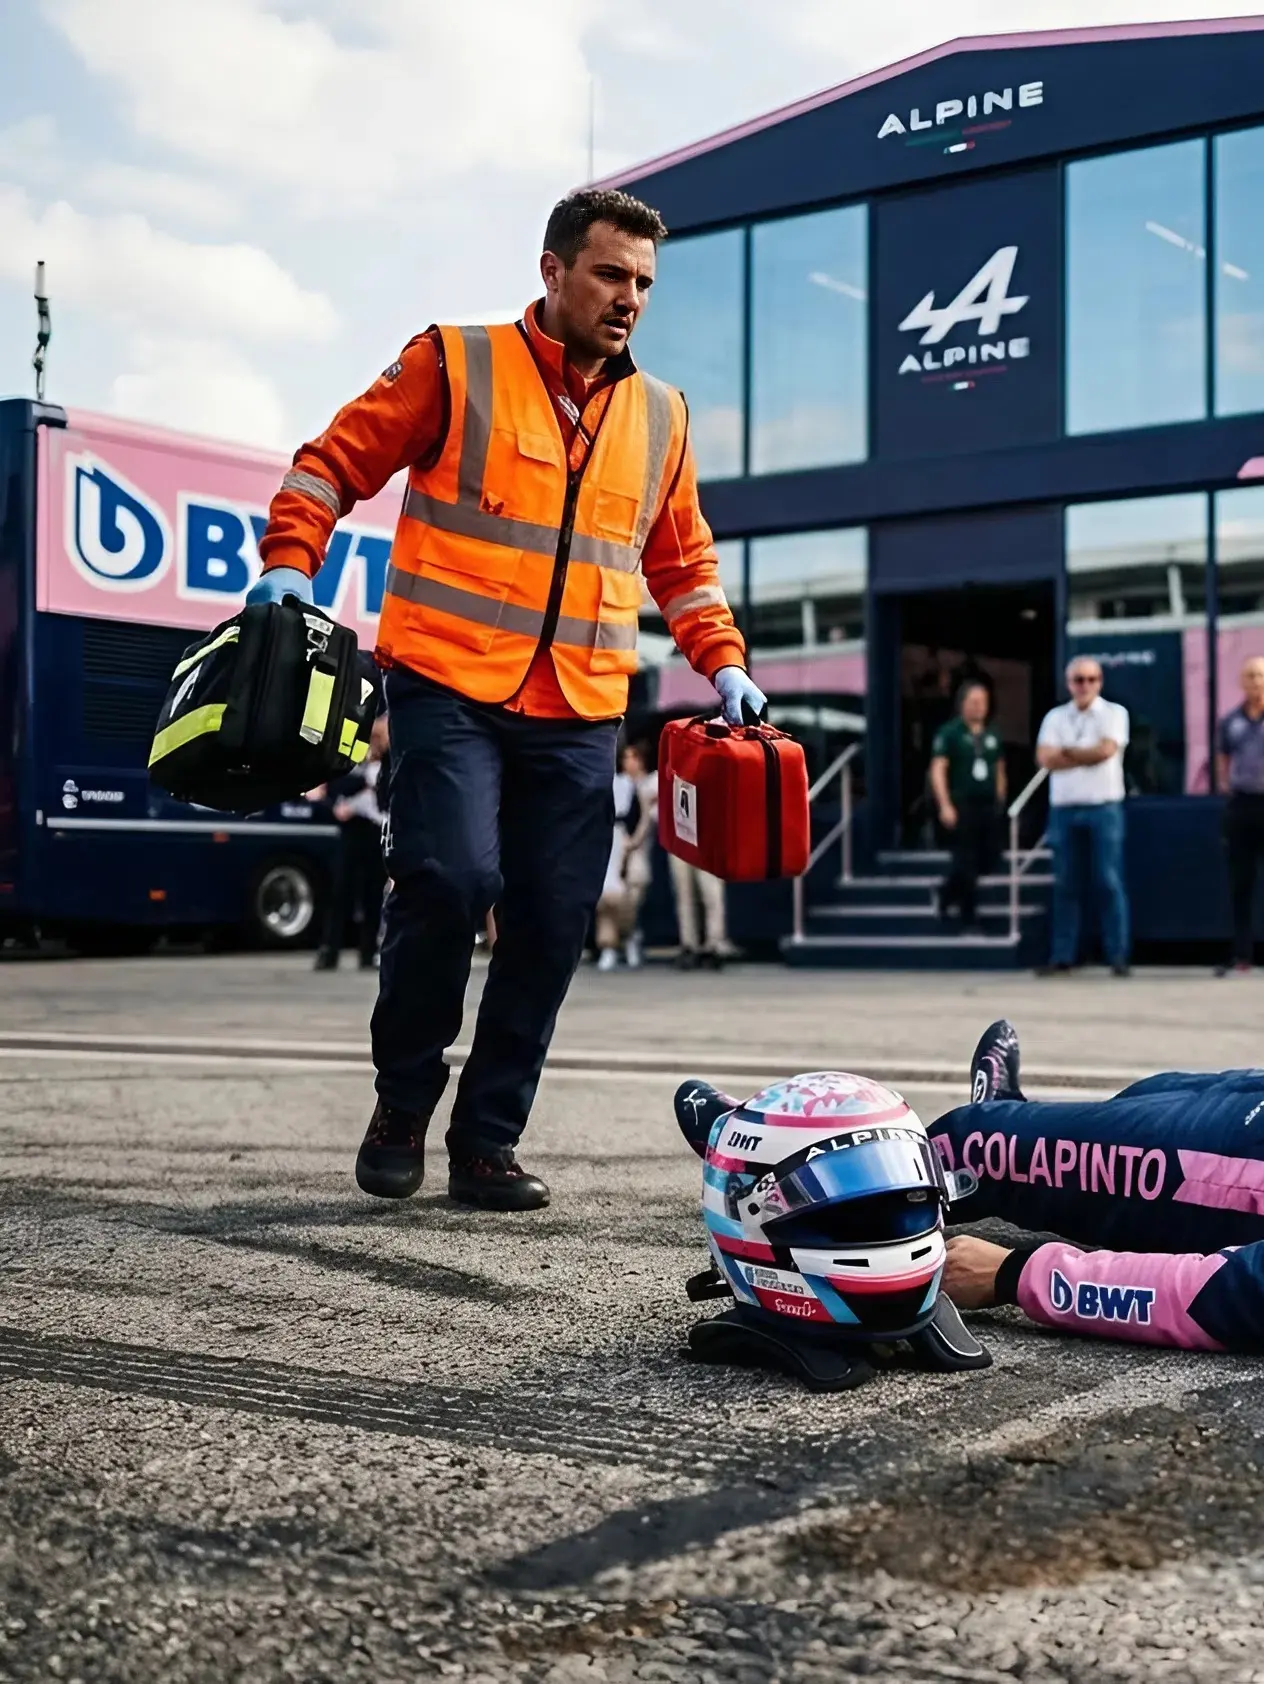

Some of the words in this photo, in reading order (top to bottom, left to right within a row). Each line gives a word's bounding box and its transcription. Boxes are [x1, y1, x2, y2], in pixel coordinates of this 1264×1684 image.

[877, 81, 1043, 138] ALPINE
[898, 337, 1030, 374] ALPINE
[963, 1131, 1166, 1200] COLAPINTO
[1077, 1283, 1155, 1324] BWT
